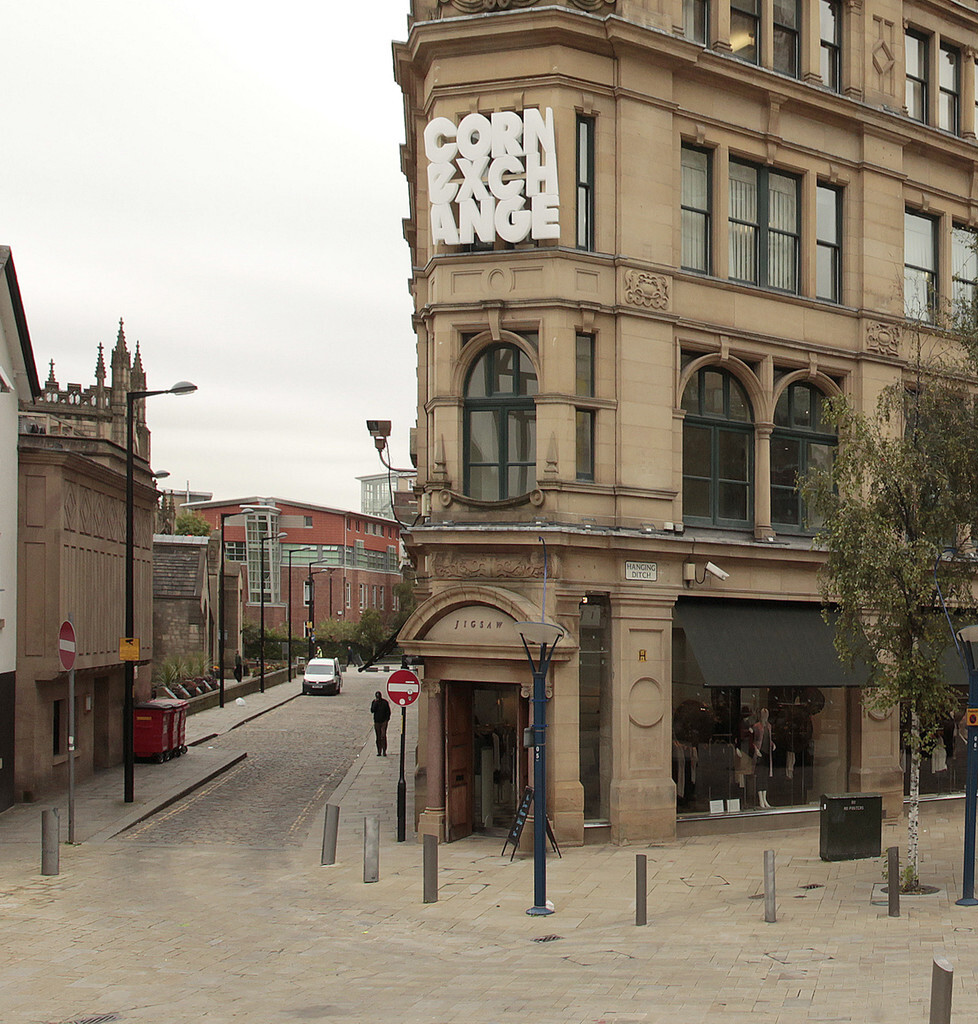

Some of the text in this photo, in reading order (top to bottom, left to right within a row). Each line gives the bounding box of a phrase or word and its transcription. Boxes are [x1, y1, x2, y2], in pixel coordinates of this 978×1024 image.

[424, 107, 556, 164] CORN
[431, 194, 561, 245] ANGE
[627, 563, 655, 571] HANGING
[632, 571, 652, 579] DITCH
[454, 620, 503, 630] JIGSAW
